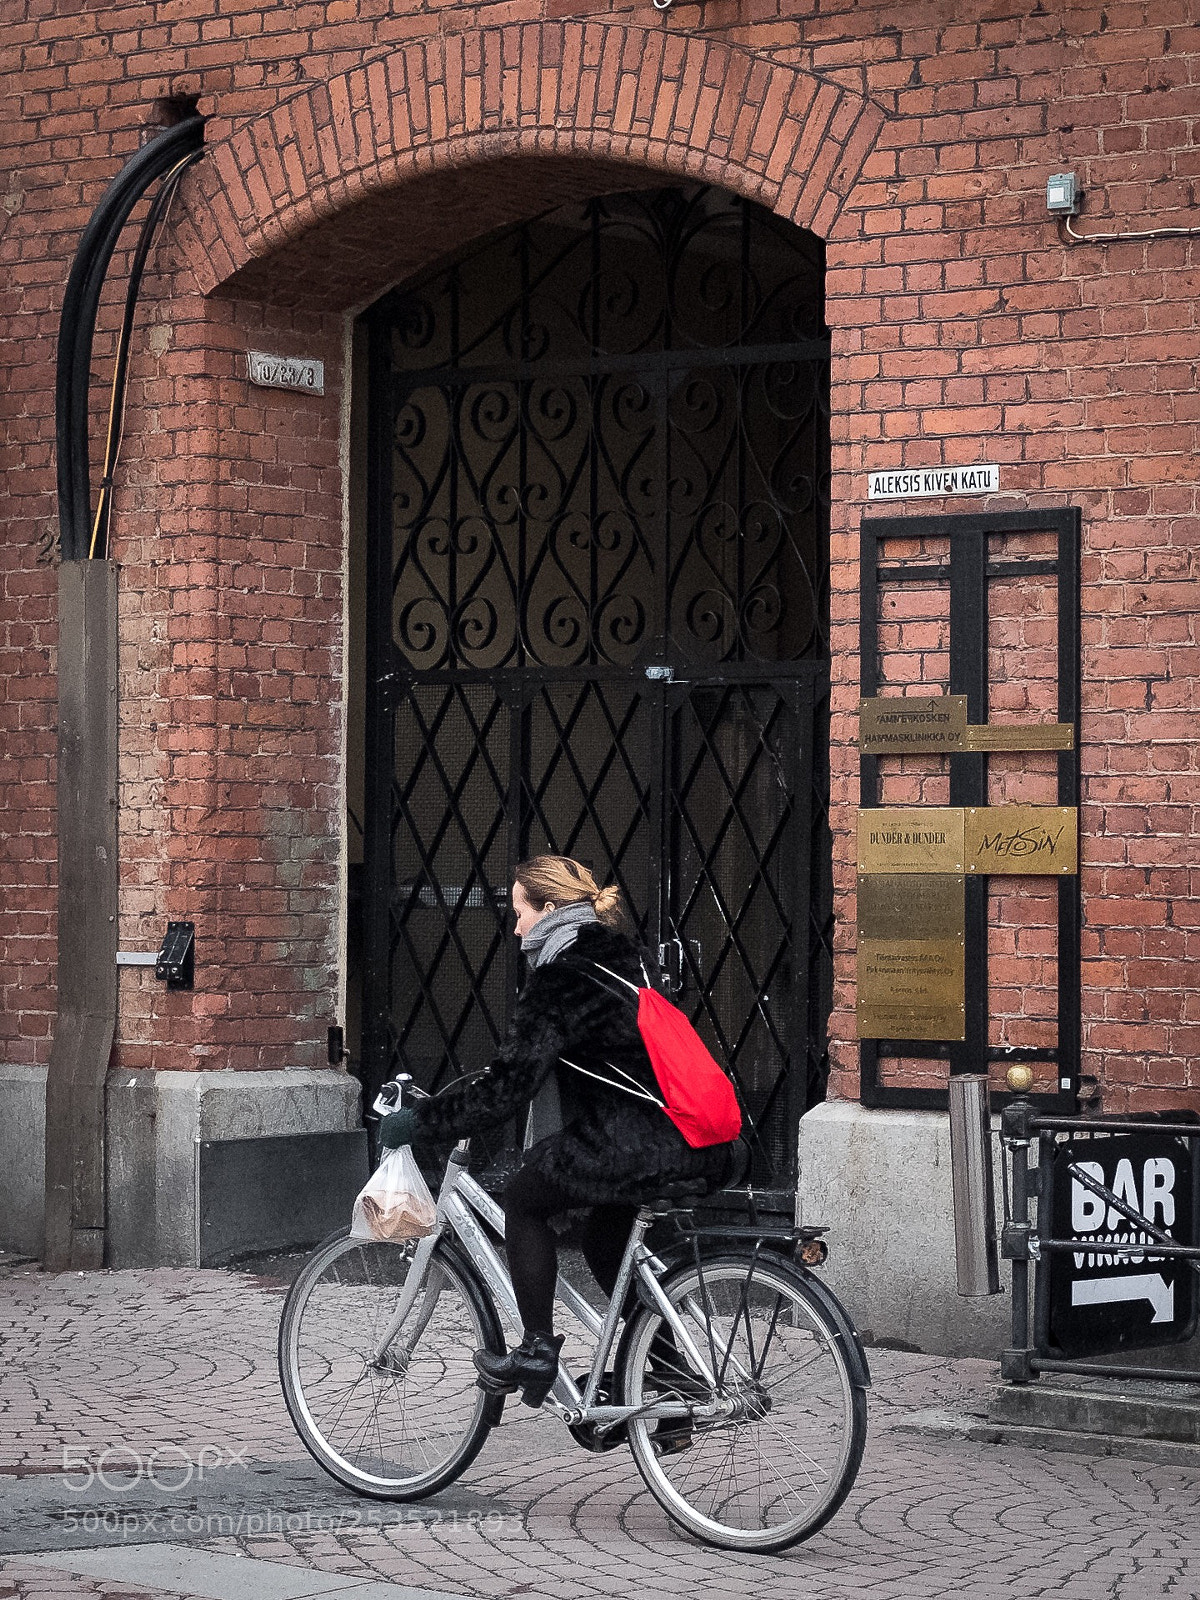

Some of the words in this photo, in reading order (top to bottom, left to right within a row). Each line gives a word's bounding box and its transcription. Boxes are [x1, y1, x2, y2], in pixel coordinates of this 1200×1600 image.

[873, 474, 921, 494] ALEKSIS
[924, 471, 958, 492] KIVEN
[961, 470, 991, 488] KATU
[864, 732, 945, 743] HAMMASKLINIKKA
[948, 732, 960, 741] OY
[904, 832, 911, 844] &
[912, 831, 946, 845] DUNDER
[1071, 1157, 1176, 1233] BAR
[1071, 1229, 1176, 1269] VIKKUL
